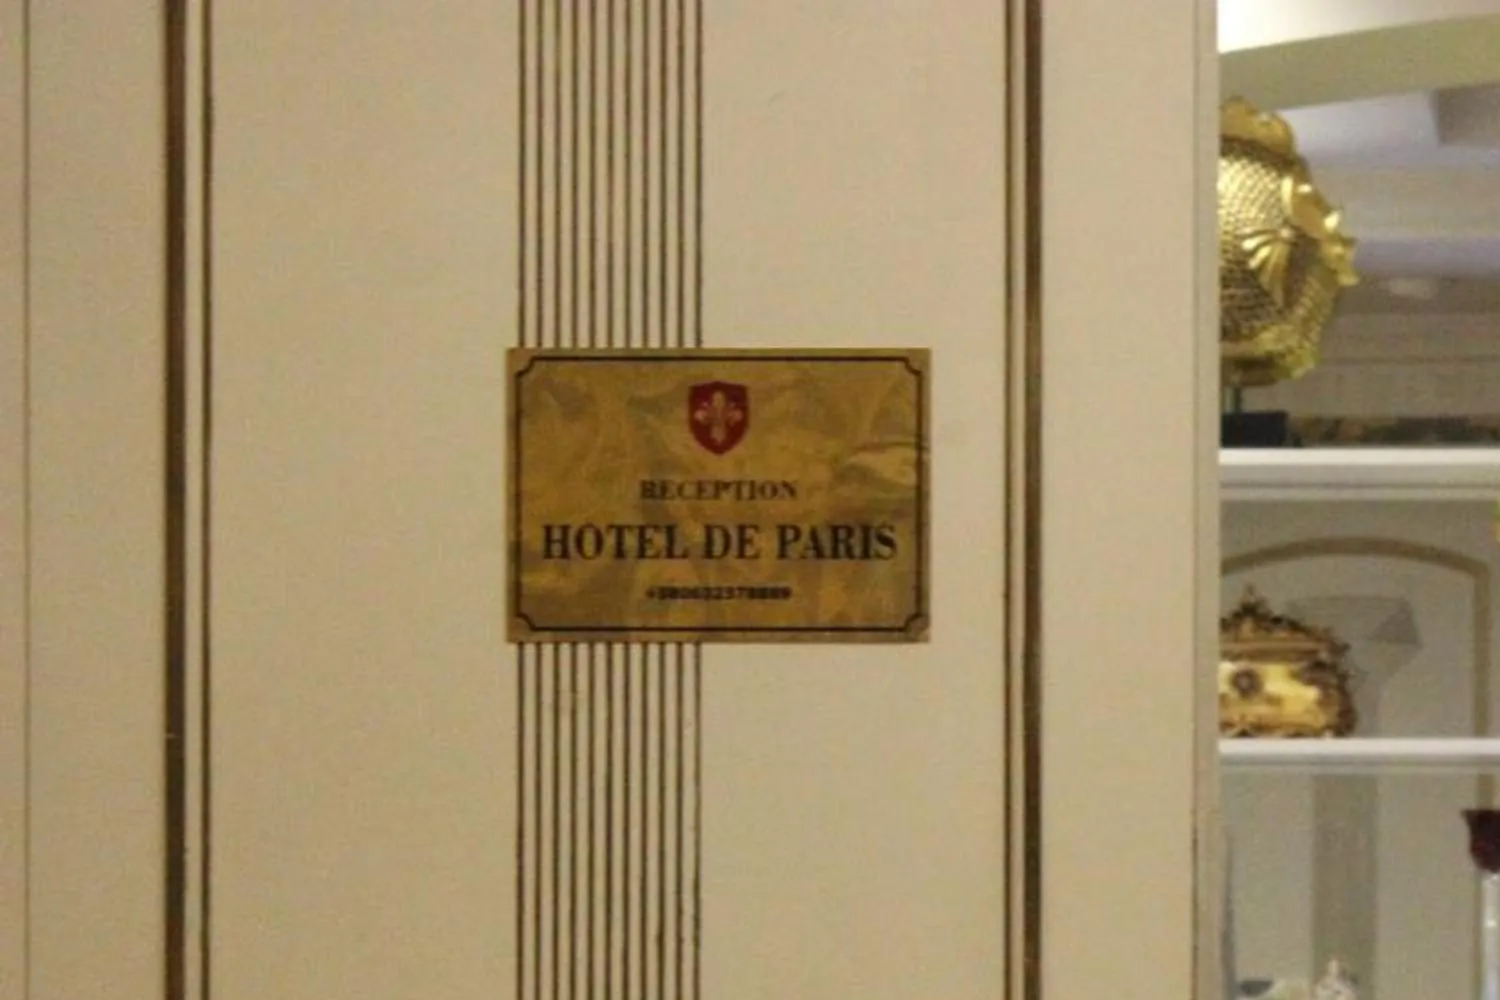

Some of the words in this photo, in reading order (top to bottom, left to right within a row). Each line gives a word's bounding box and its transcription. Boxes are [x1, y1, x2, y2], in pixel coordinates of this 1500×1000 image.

[640, 478, 799, 501] RECEPTION
[541, 522, 689, 561] HOTEL
[702, 523, 761, 560] DE
[776, 523, 899, 562] PARIS
